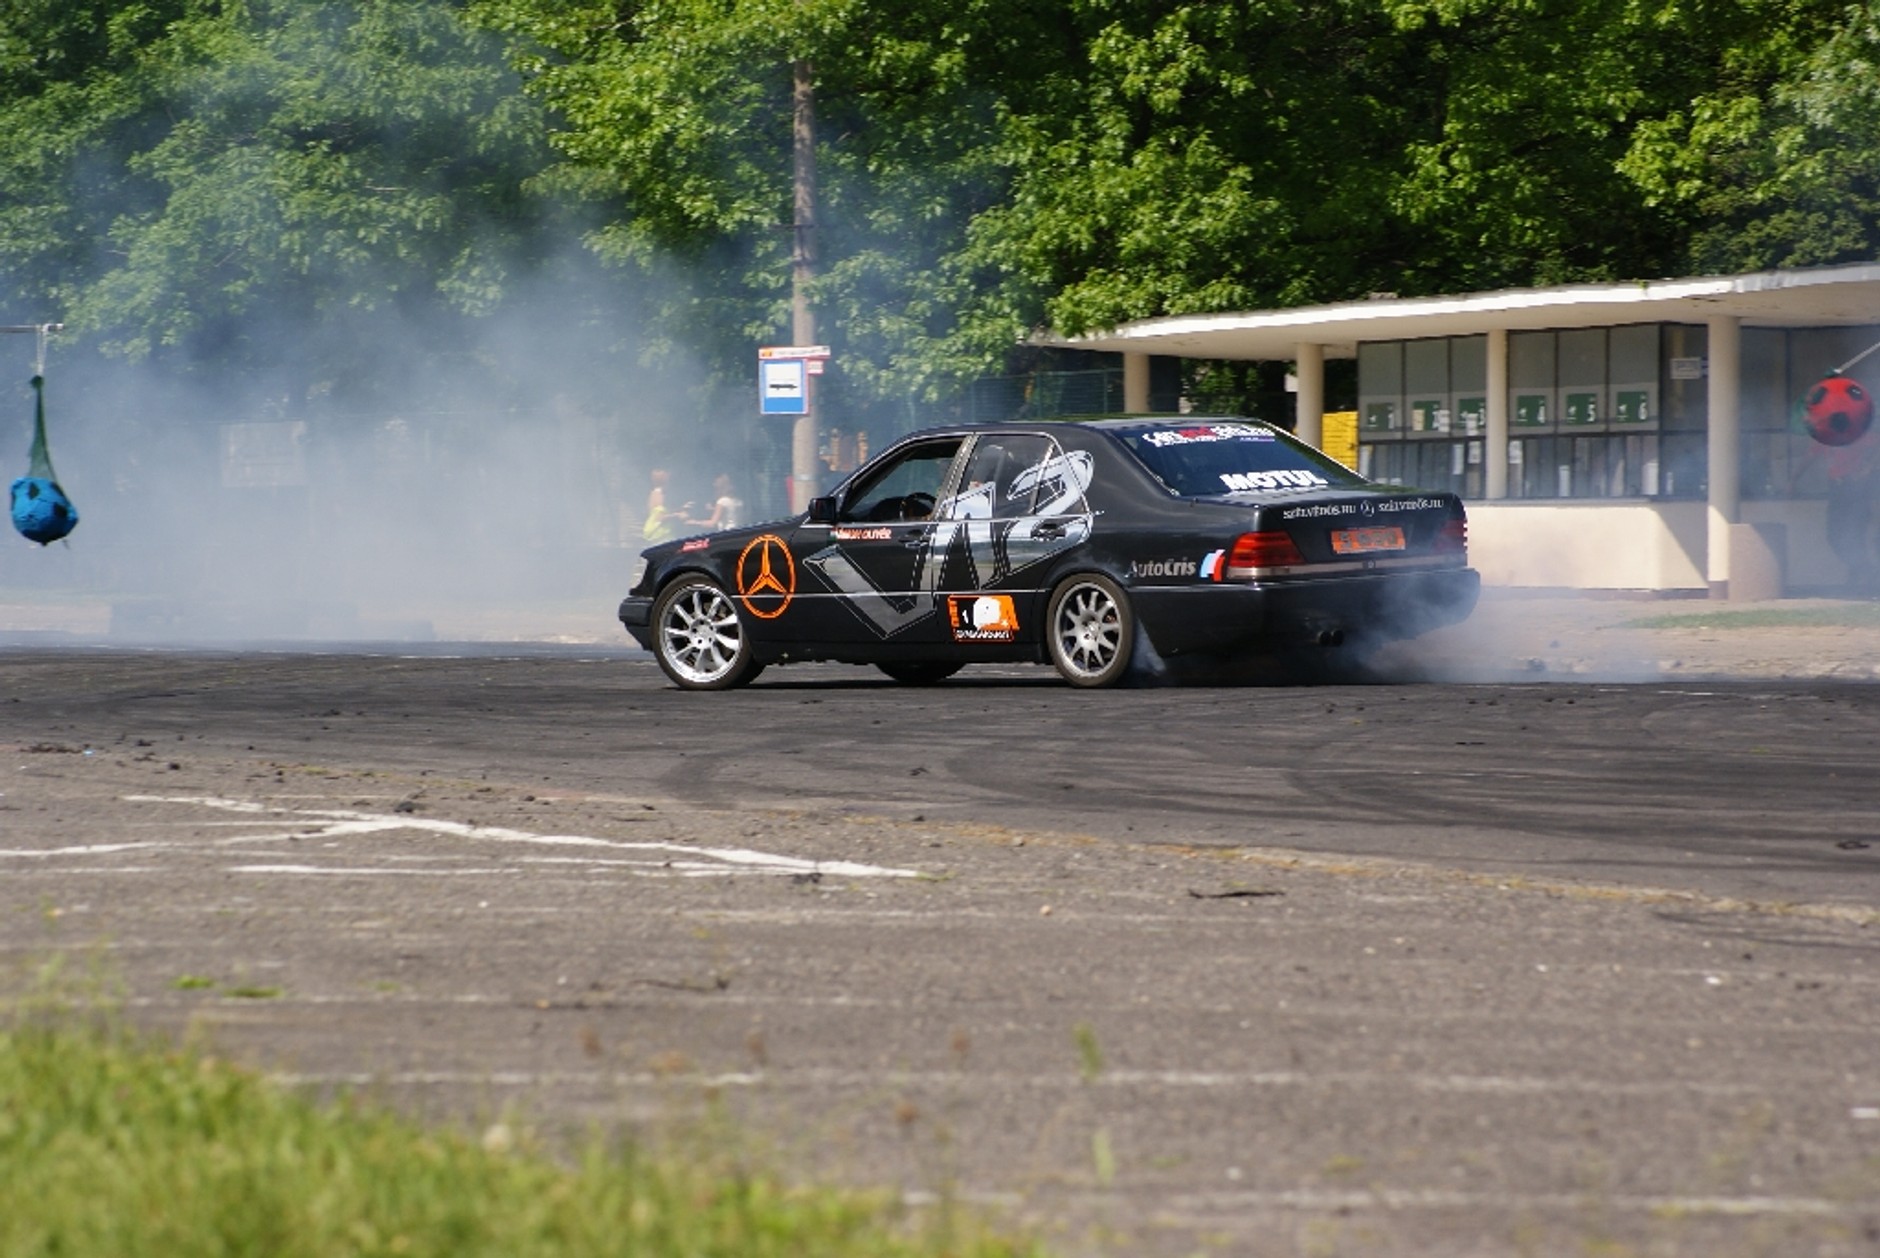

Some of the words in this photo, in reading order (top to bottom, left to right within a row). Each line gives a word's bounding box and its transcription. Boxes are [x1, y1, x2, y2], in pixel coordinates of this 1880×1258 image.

[1586, 403, 1596, 421] 5
[1638, 402, 1647, 420] 6
[1219, 470, 1329, 490] MOTUL
